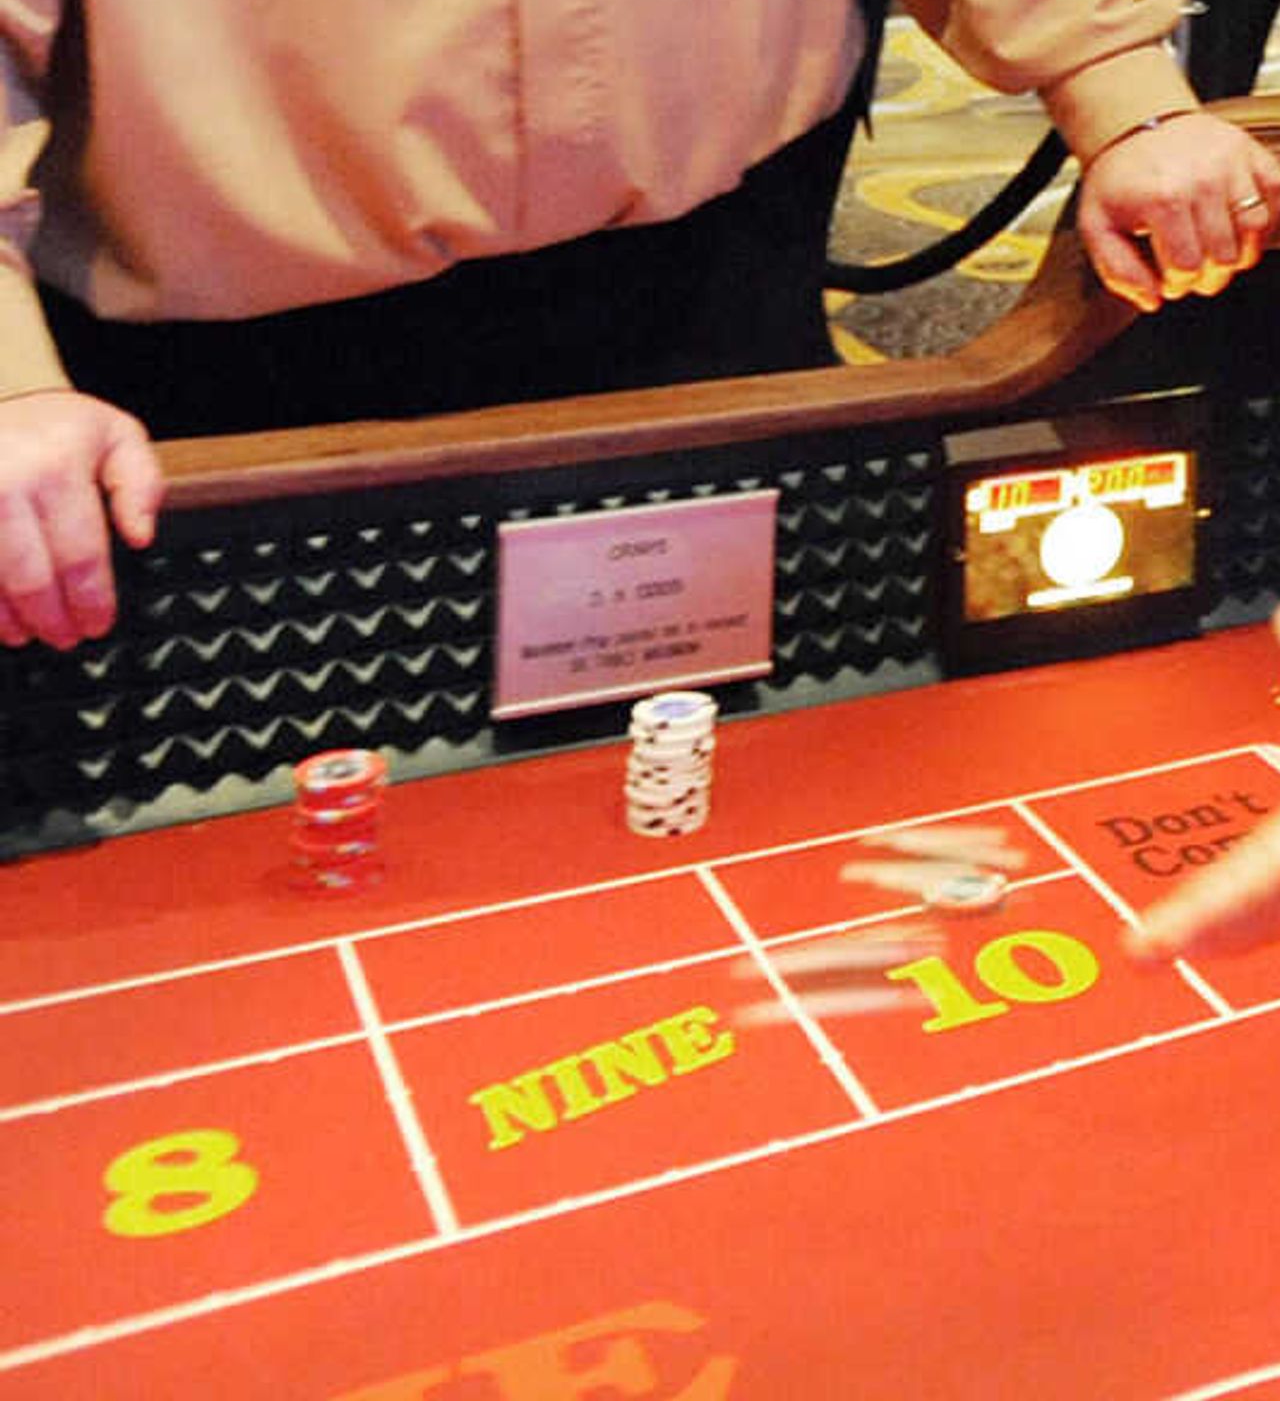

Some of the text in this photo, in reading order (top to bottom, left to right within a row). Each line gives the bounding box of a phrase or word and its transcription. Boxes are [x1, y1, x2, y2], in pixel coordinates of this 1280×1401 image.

[1095, 791, 1269, 846] Don't
[884, 929, 1100, 1034] 10
[467, 1004, 736, 1151] NINE
[102, 1128, 258, 1238] 8
